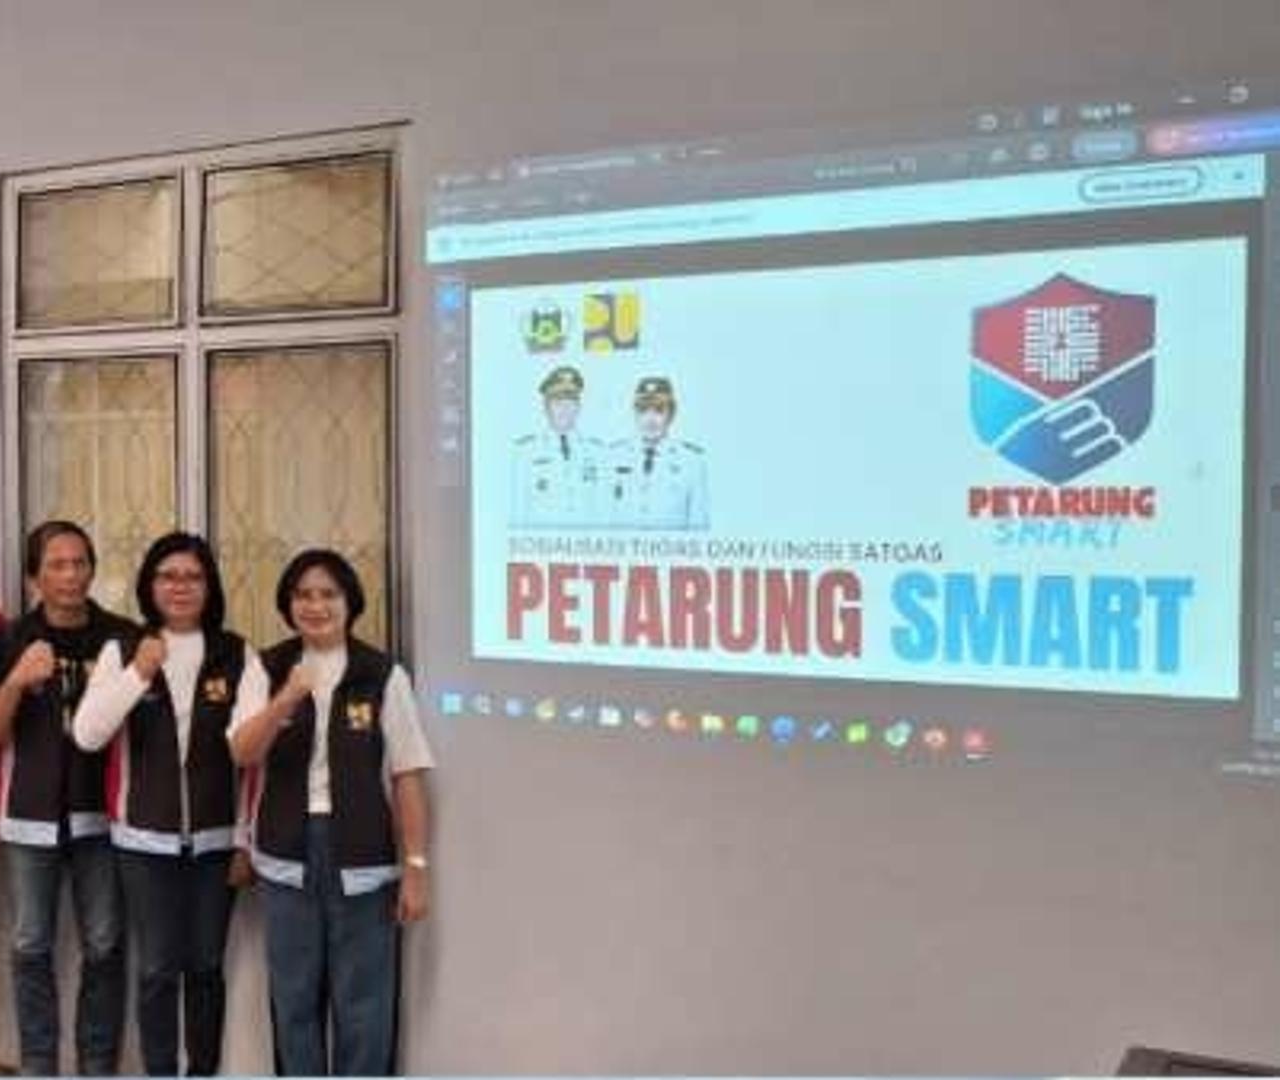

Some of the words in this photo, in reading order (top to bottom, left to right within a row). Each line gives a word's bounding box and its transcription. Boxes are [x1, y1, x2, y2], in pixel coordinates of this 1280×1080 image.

[967, 486, 1157, 518] PETARUNG
[706, 540, 755, 561] DAN
[506, 561, 864, 660] PETARUNG
[889, 571, 1196, 675] SMART
